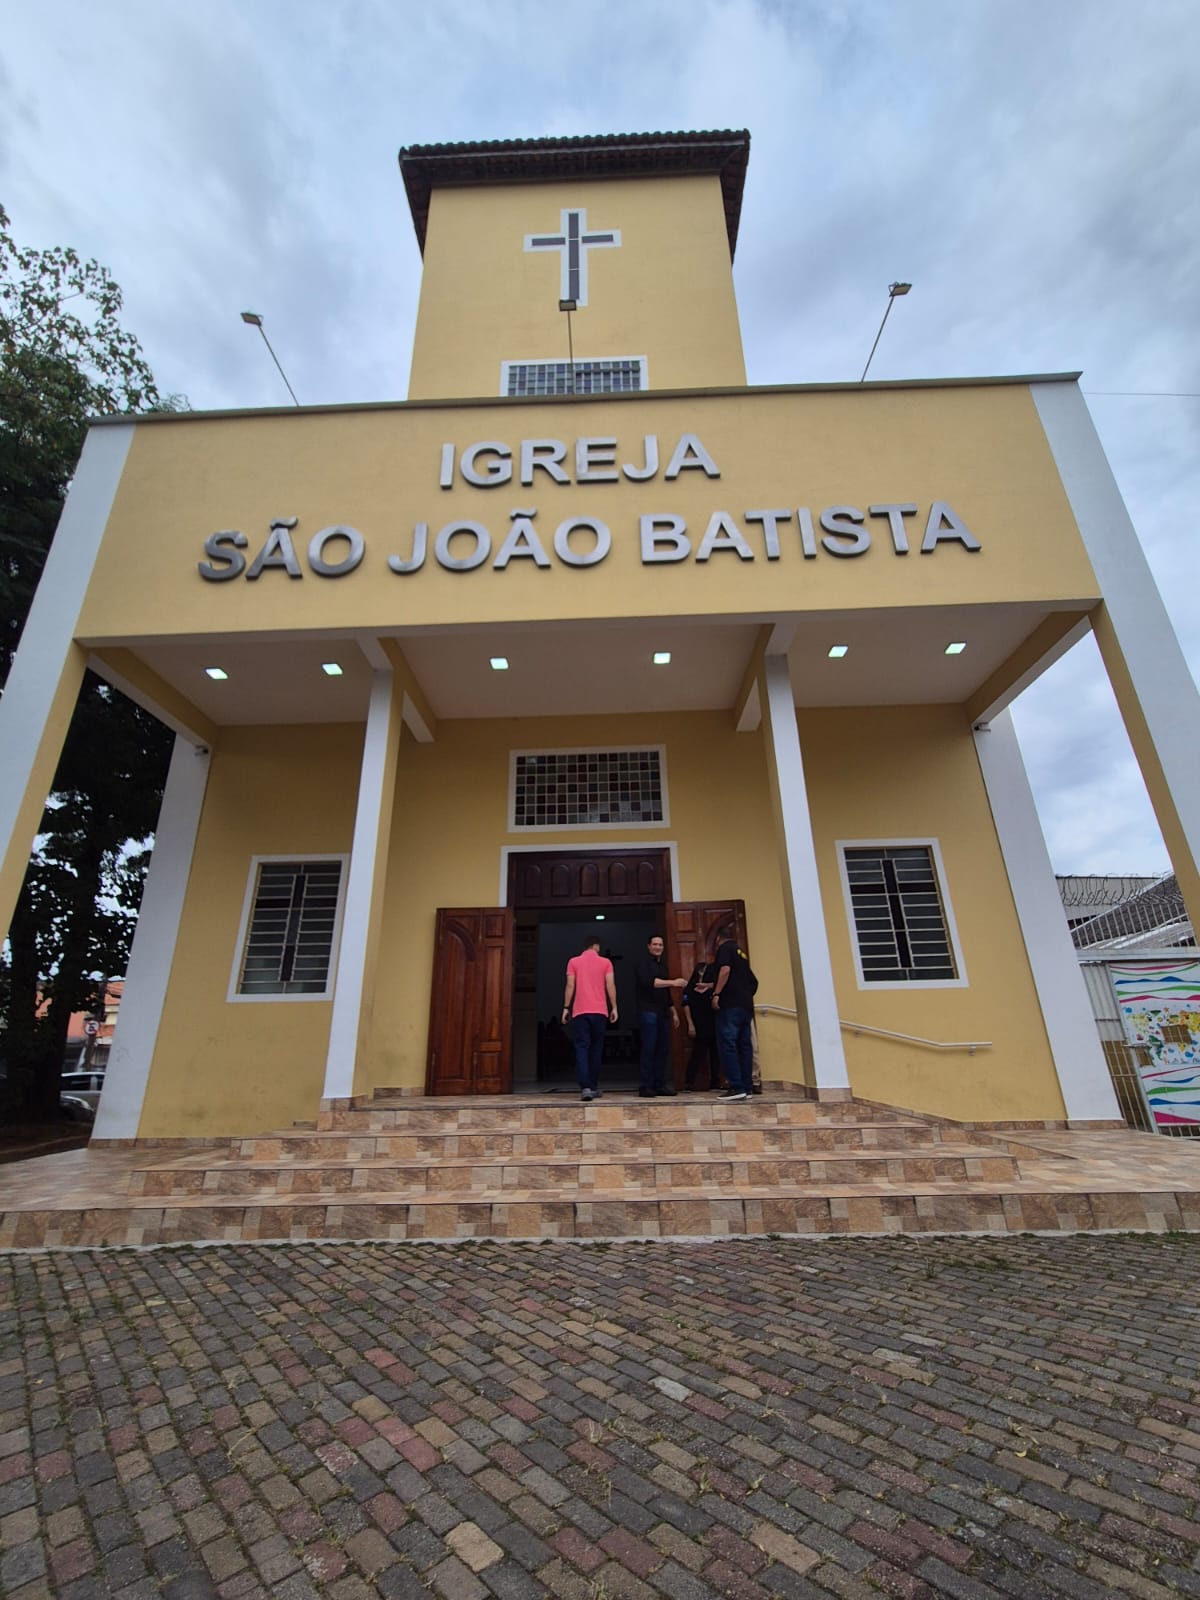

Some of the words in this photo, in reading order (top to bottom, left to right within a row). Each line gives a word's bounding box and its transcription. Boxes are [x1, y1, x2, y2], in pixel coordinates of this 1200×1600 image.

[438, 433, 721, 490] IGREJA
[198, 515, 366, 582] SÃO
[387, 507, 612, 574] JOÃO
[639, 501, 982, 565] BATISTA
